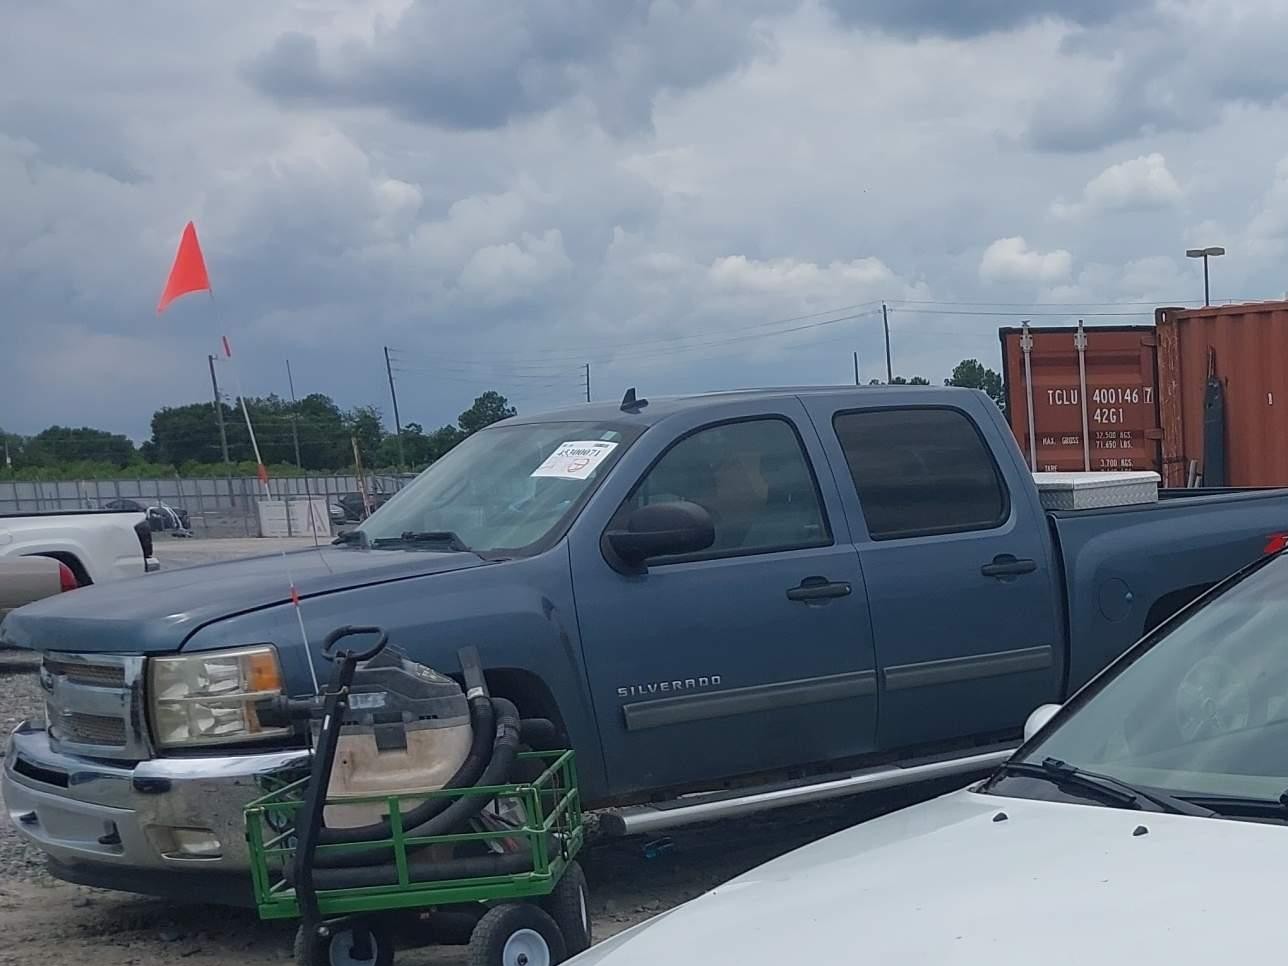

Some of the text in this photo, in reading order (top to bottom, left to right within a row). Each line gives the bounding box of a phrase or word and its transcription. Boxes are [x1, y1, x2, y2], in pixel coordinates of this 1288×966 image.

[1048, 387, 1153, 405] TCLU 400146 7
[1094, 408, 1124, 423] 42G1
[617, 675, 721, 696] SILVERADO
